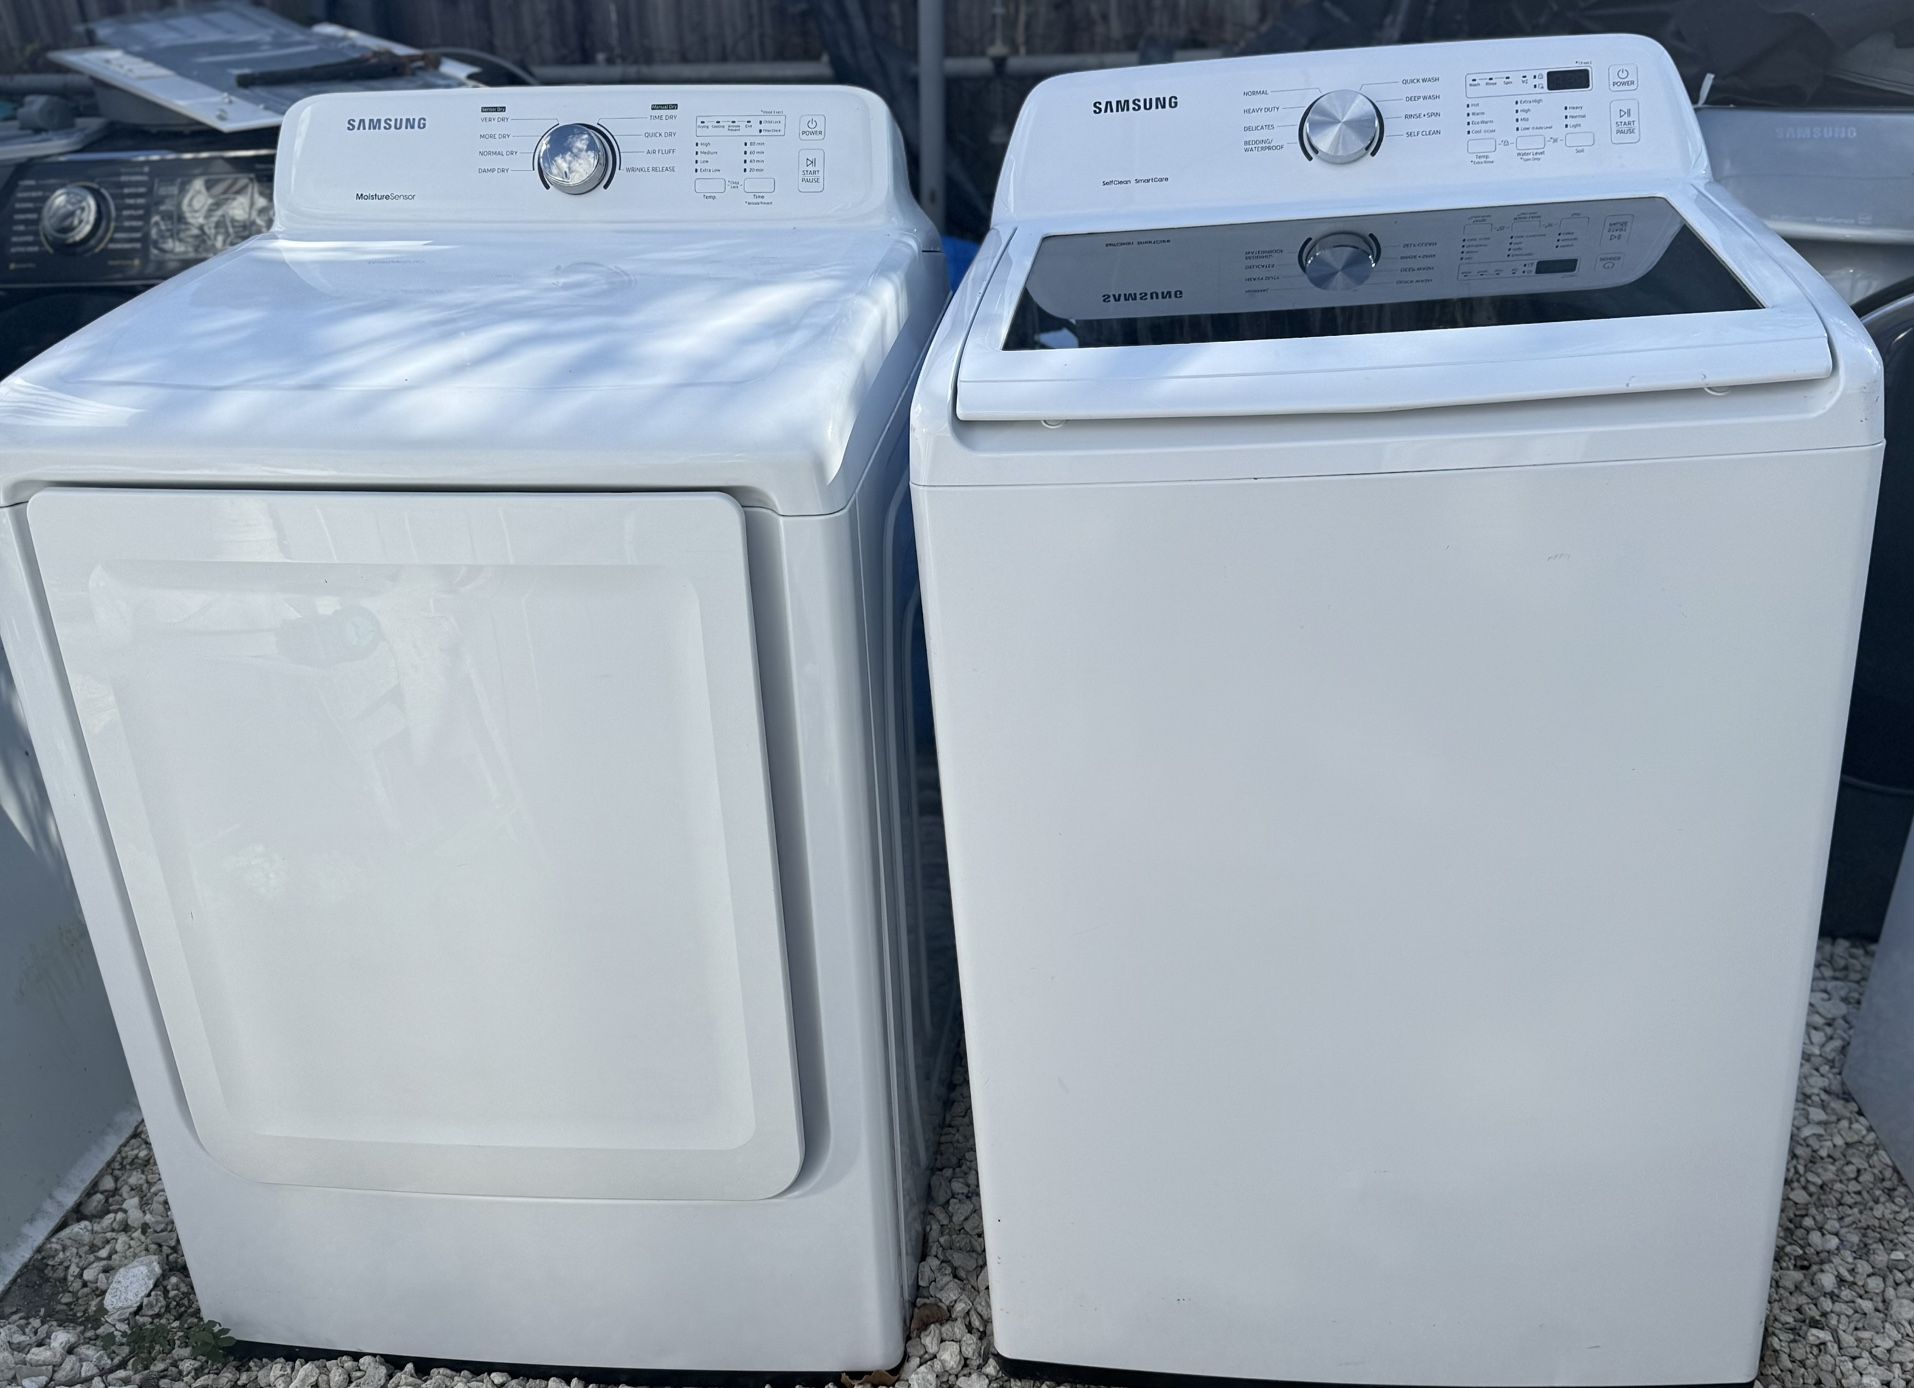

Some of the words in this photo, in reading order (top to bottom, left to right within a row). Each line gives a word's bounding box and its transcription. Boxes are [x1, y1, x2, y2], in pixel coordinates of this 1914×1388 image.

[1093, 95, 1178, 114] SAMSUNG
[347, 117, 427, 131] SAMSUNG
[1776, 127, 1857, 138] SAMSUNG
[355, 193, 416, 201] MoistureSensor
